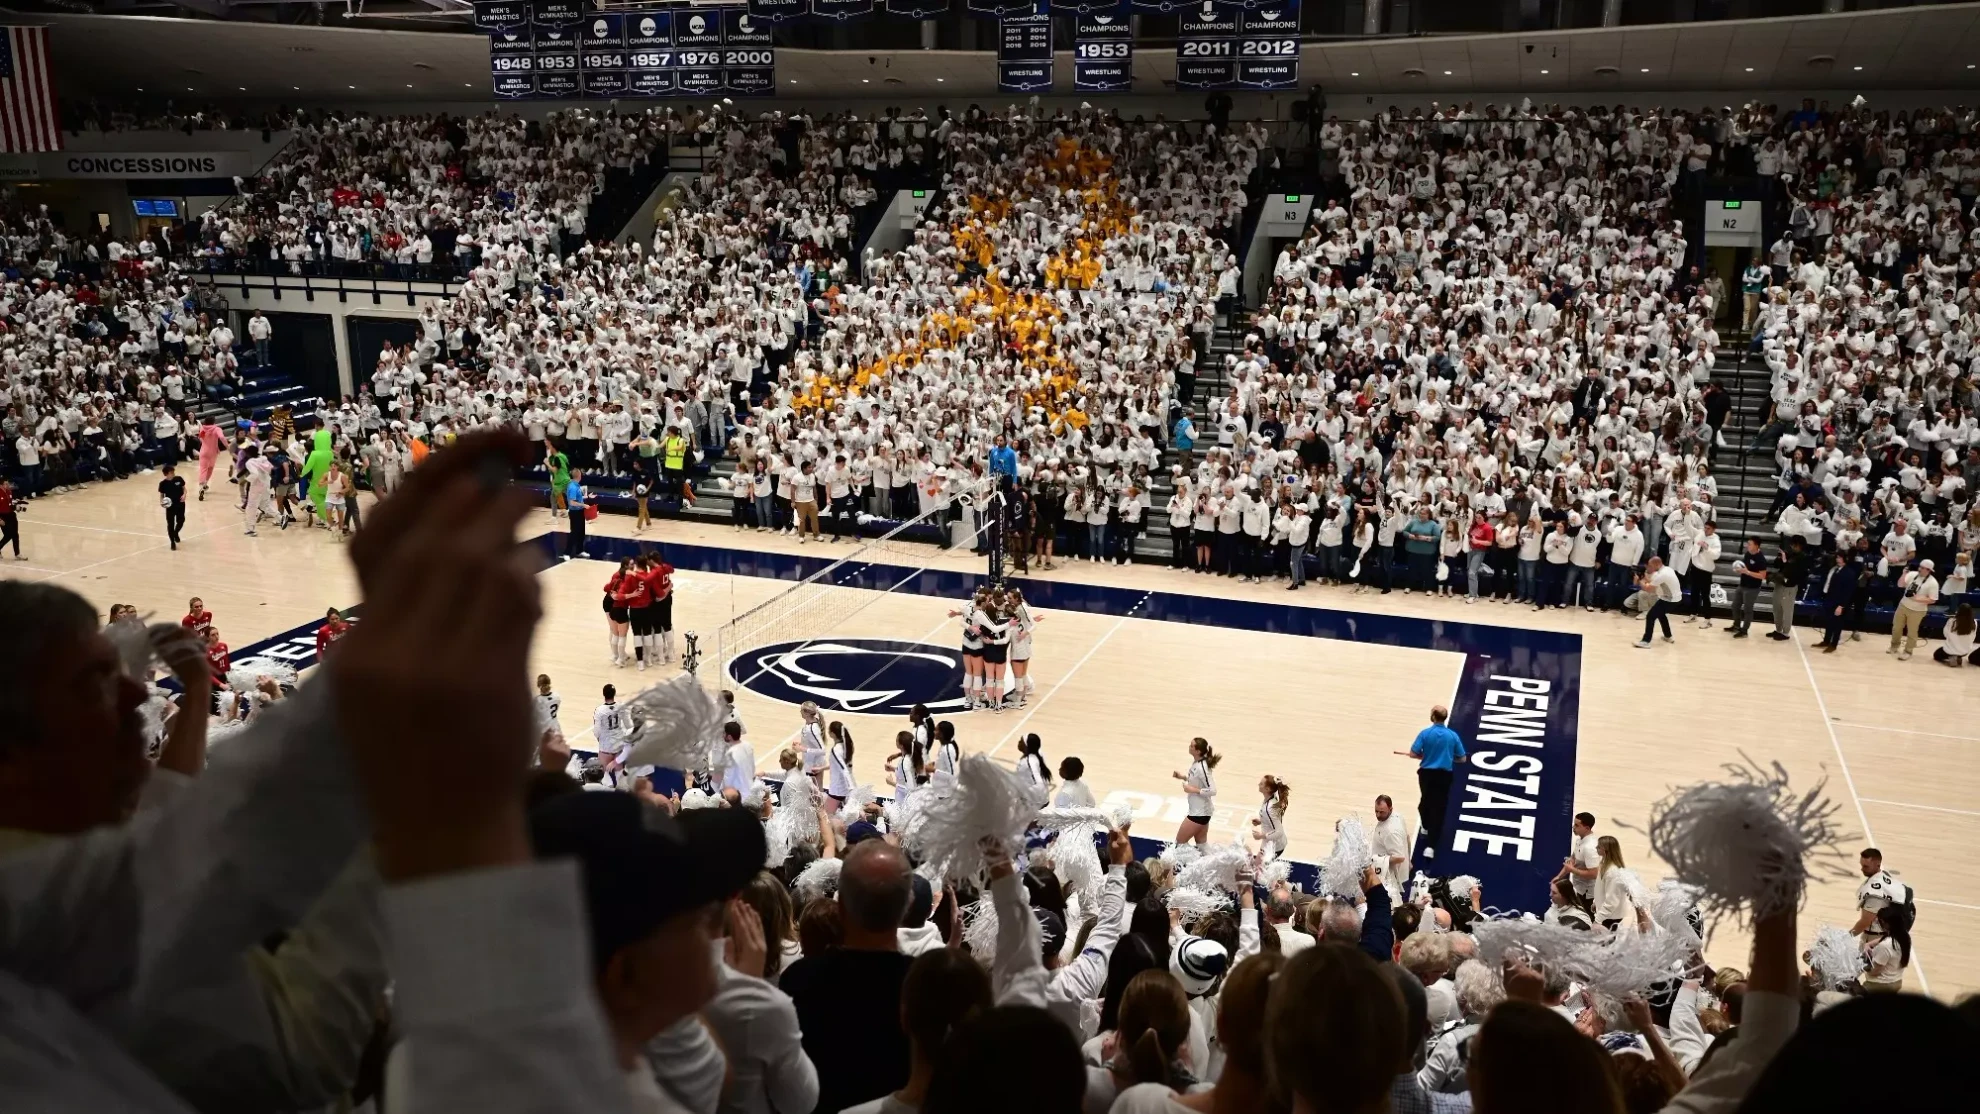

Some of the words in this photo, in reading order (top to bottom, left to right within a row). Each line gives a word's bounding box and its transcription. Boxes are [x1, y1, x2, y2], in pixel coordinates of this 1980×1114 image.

[481, 13, 520, 21] GYMNASTICS
[538, 11, 578, 19] GYMNASTICS
[1080, 24, 1129, 33] CHAMPIONS
[1183, 22, 1235, 31] CHAMPIONS
[1245, 21, 1297, 29] CHAMPIONS
[583, 38, 622, 46] CHAMPIONS
[629, 36, 669, 44] CHAMPIONS
[678, 35, 719, 43] CHAMPIONS
[728, 34, 770, 42] CHAMPIONS
[493, 42, 530, 50] CHAMPIONS
[537, 40, 574, 48] CHAMPIONS
[1183, 42, 1230, 56] 2011
[1242, 41, 1296, 54] 2012
[1079, 43, 1129, 57] 1953
[537, 56, 575, 69] 1953
[584, 55, 623, 67] 1954
[630, 53, 671, 67] 1957
[679, 51, 720, 65] 1976
[726, 51, 772, 64] 2000
[493, 57, 532, 70] 1948
[67, 158, 216, 173] CONCESSIONS
[914, 205, 924, 213] N4
[1285, 211, 1296, 220] N3
[1723, 219, 1737, 228] N2
[550, 704, 558, 718] 2
[1476, 674, 1551, 748] PENN
[607, 714, 619, 730] 11
[1452, 751, 1543, 861] STATE
